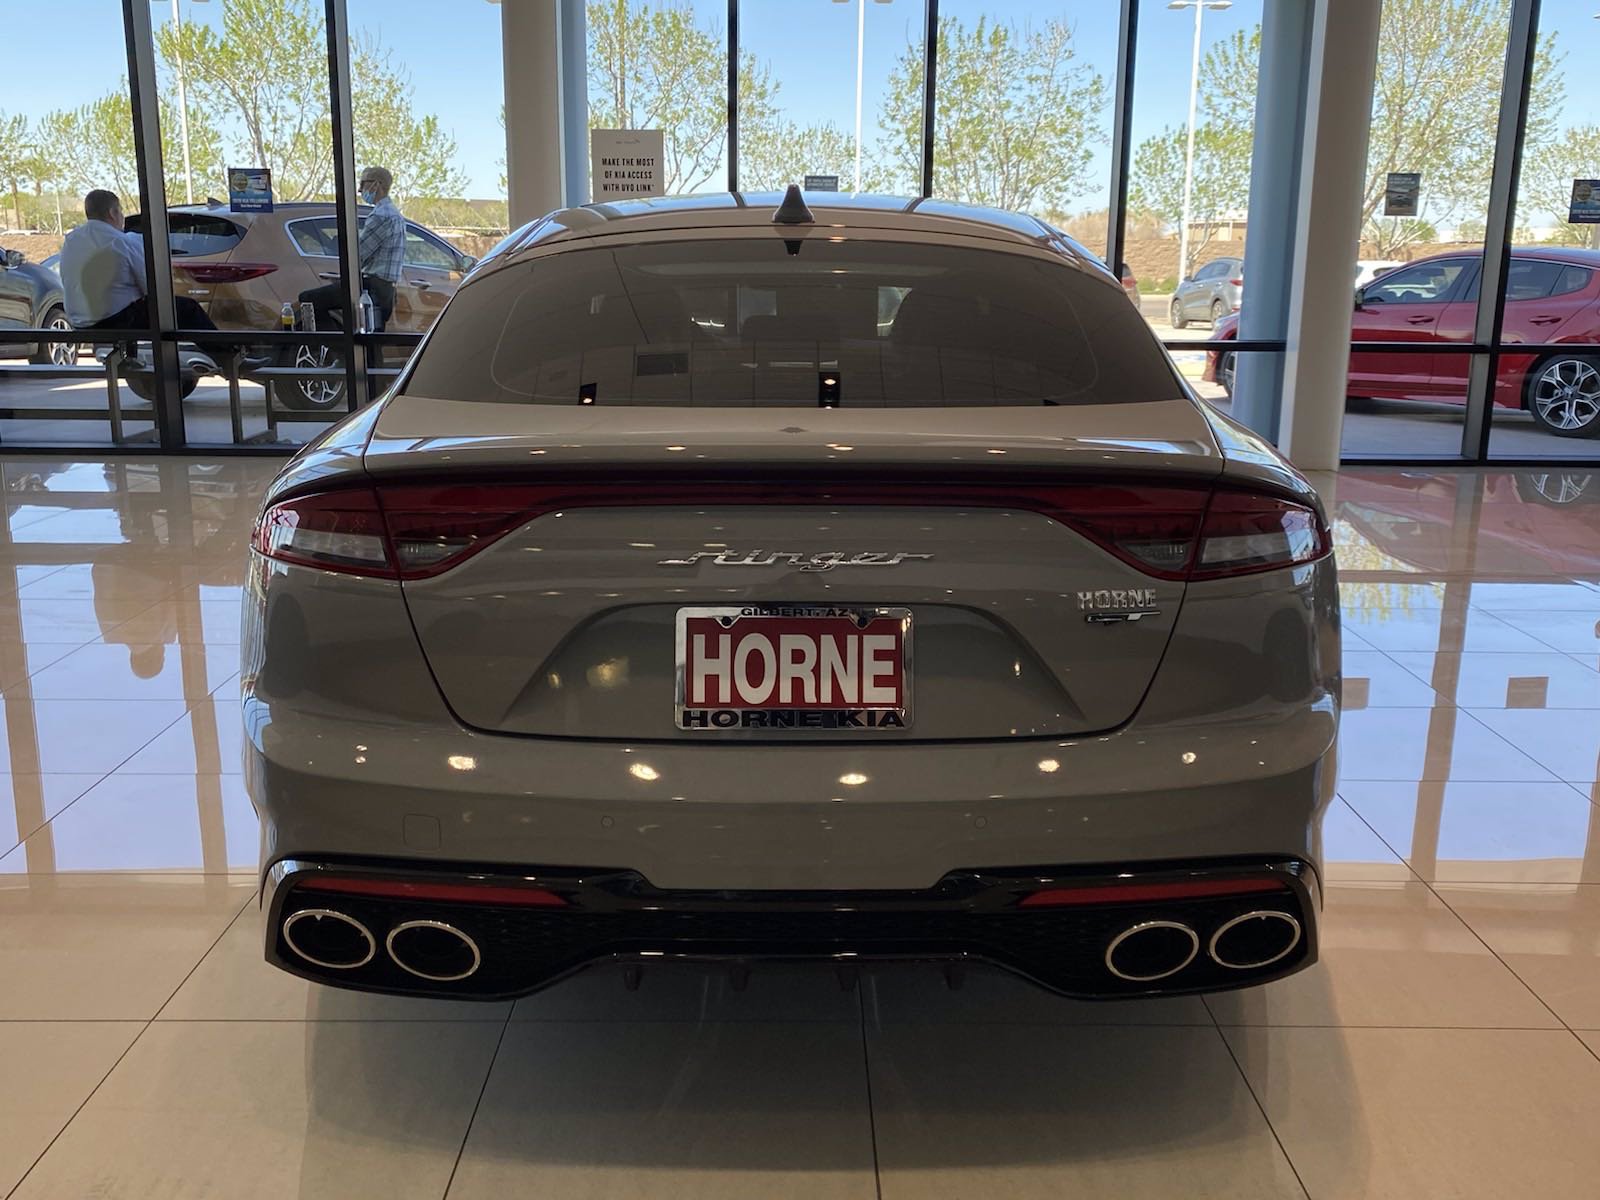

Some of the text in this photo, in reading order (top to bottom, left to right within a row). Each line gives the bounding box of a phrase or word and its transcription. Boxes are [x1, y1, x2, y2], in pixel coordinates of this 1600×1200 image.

[602, 158, 655, 166] MAKE THE MOST
[604, 171, 652, 179] OF KIA ACCESS
[602, 184, 620, 192] WITH
[1077, 588, 1157, 609] HORNE
[826, 608, 849, 617] AZ
[693, 633, 896, 704] HORNE
[682, 710, 904, 728] HORNE KIA
